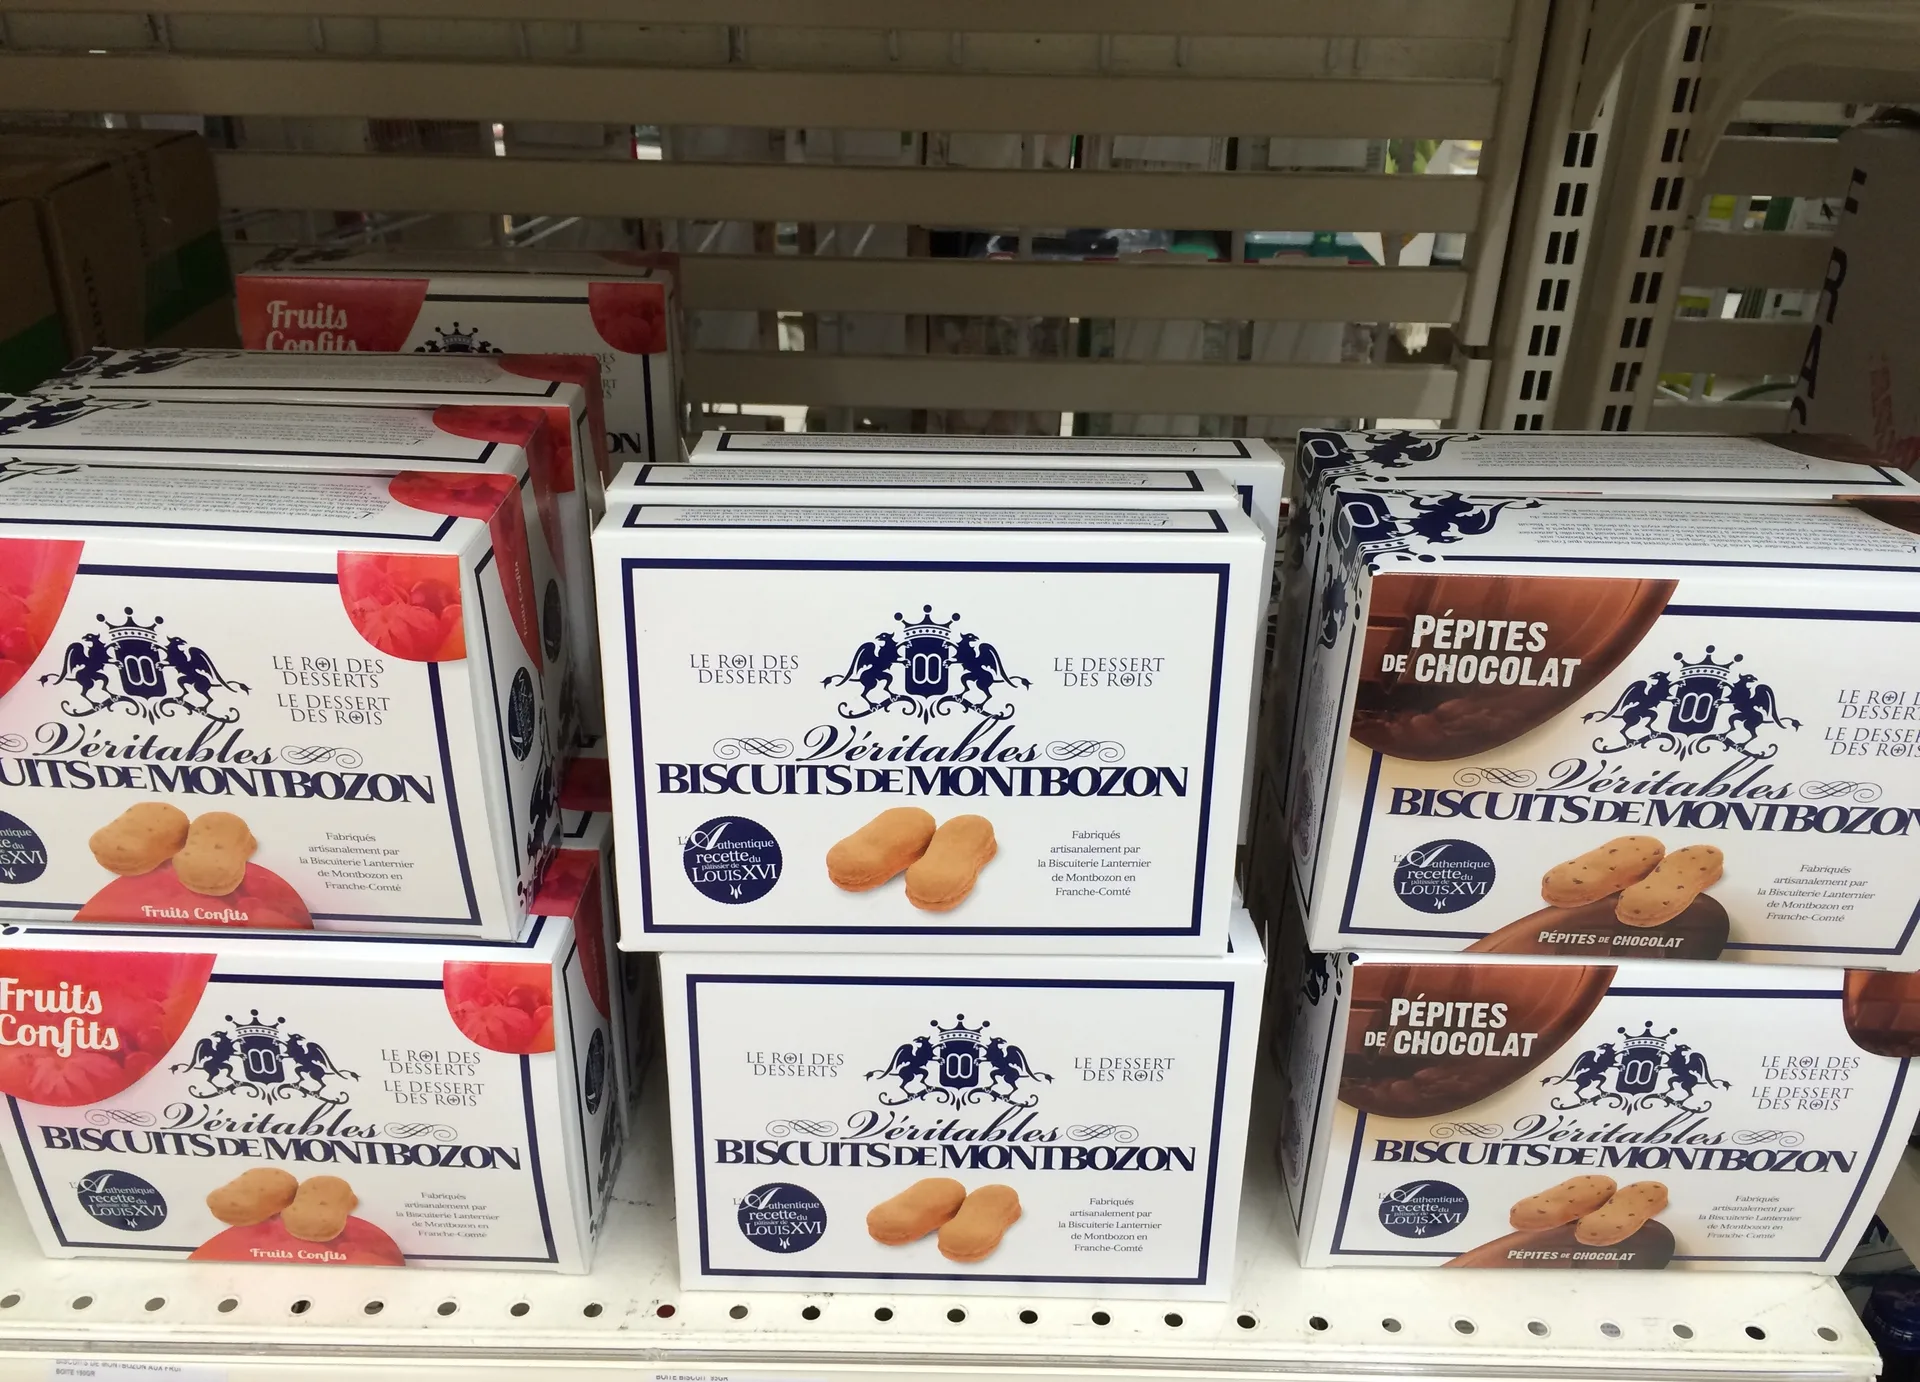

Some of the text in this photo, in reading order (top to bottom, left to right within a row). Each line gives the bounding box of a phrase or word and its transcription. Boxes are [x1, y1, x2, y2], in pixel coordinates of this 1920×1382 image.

[267, 300, 347, 329] Fruits
[1411, 610, 1549, 652] PÉPITES
[272, 656, 384, 674] LE ROI DES
[690, 654, 799, 670] LE ROI DES
[1053, 657, 1165, 673] LE DESSERT
[699, 669, 792, 684] DESSERTS
[1382, 653, 1582, 688] DE CHOCOLAT
[283, 672, 379, 688] DESSERTS
[1063, 672, 1154, 688] DES ROIS
[277, 694, 390, 711] LE DESSERT
[1838, 689, 1860, 703] LE
[1867, 690, 1906, 705] ROI
[291, 709, 383, 726] DES ROIS
[1841, 705, 1920, 720] DESSER
[32, 719, 278, 765] Véritables
[796, 714, 1042, 764] Véritables
[1824, 727, 1920, 743] LE DESSE
[1831, 742, 1869, 756] DES
[0, 757, 435, 804] UITS DE MONTBOZON
[656, 763, 1188, 798] BISCUITS DE MONTBOZON
[1535, 756, 1795, 800] Véritables
[1387, 786, 1590, 823] BISCUITS
[1592, 801, 1644, 824] DE
[326, 832, 376, 842] Fabriqués
[1072, 830, 1120, 840] Fabriqués
[308, 845, 400, 856] artisanalement par
[696, 850, 748, 863] recette
[1050, 845, 1141, 855] artisanalement par
[310, 857, 361, 866] Biscuiterie
[363, 859, 414, 868] Lanternier
[1038, 859, 1151, 868] la Biscuiterie Lanternier
[1800, 864, 1851, 874] Fabriqués
[332, 870, 388, 879] Montbozon
[1407, 869, 1461, 879] recette
[1774, 877, 1848, 886] artisanalement
[325, 882, 401, 891] Franche-Comté
[1055, 887, 1131, 896] Franche-Comté
[1769, 888, 1820, 897] Biscuiterie
[1823, 891, 1875, 899] Lanternier
[141, 905, 249, 922] Fruits Confits
[1782, 901, 1839, 910] Montbozon
[1766, 912, 1845, 922] Franche-Comté
[1537, 931, 1596, 945] PÉPITES
[1612, 934, 1684, 948] CHOCOLAT
[0, 978, 102, 1015] Fruits
[1390, 994, 1509, 1029] PÉPITES
[0, 1014, 119, 1057] Confits
[1364, 1031, 1538, 1058] DE CHOCOLAT
[381, 1049, 481, 1065] LE ROI DES
[746, 1052, 844, 1066] LE ROI DES
[1074, 1057, 1175, 1071] LE DESSERT
[1761, 1055, 1861, 1070] LE ROI DES
[390, 1062, 476, 1077] DESSERTS
[753, 1064, 838, 1078] DESSERTS
[1082, 1069, 1164, 1084] DES ROIS
[1764, 1067, 1851, 1081] DESSERTS
[383, 1080, 484, 1096] LE DESSERT
[1751, 1086, 1853, 1099] LE DESSERT
[395, 1093, 477, 1107] DES ROIS
[1757, 1097, 1842, 1111] DES ROIS
[161, 1099, 381, 1140] Véritables
[846, 1103, 1060, 1143] Véritables
[1504, 1111, 1729, 1146] Véritables
[38, 1126, 520, 1170] BISCUITS DE MONTBOZON
[715, 1138, 1196, 1172] BISCUITS DE MONTBOZON
[1372, 1139, 1857, 1173] BISCUITS DE MONTBOZON
[1090, 1198, 1134, 1206] Fabriqués
[749, 1210, 796, 1220] recette
[249, 1247, 347, 1263] Fruits Confits
[1508, 1249, 1559, 1261] PÉPITES
[1574, 1251, 1635, 1262] CHOCOLAT
